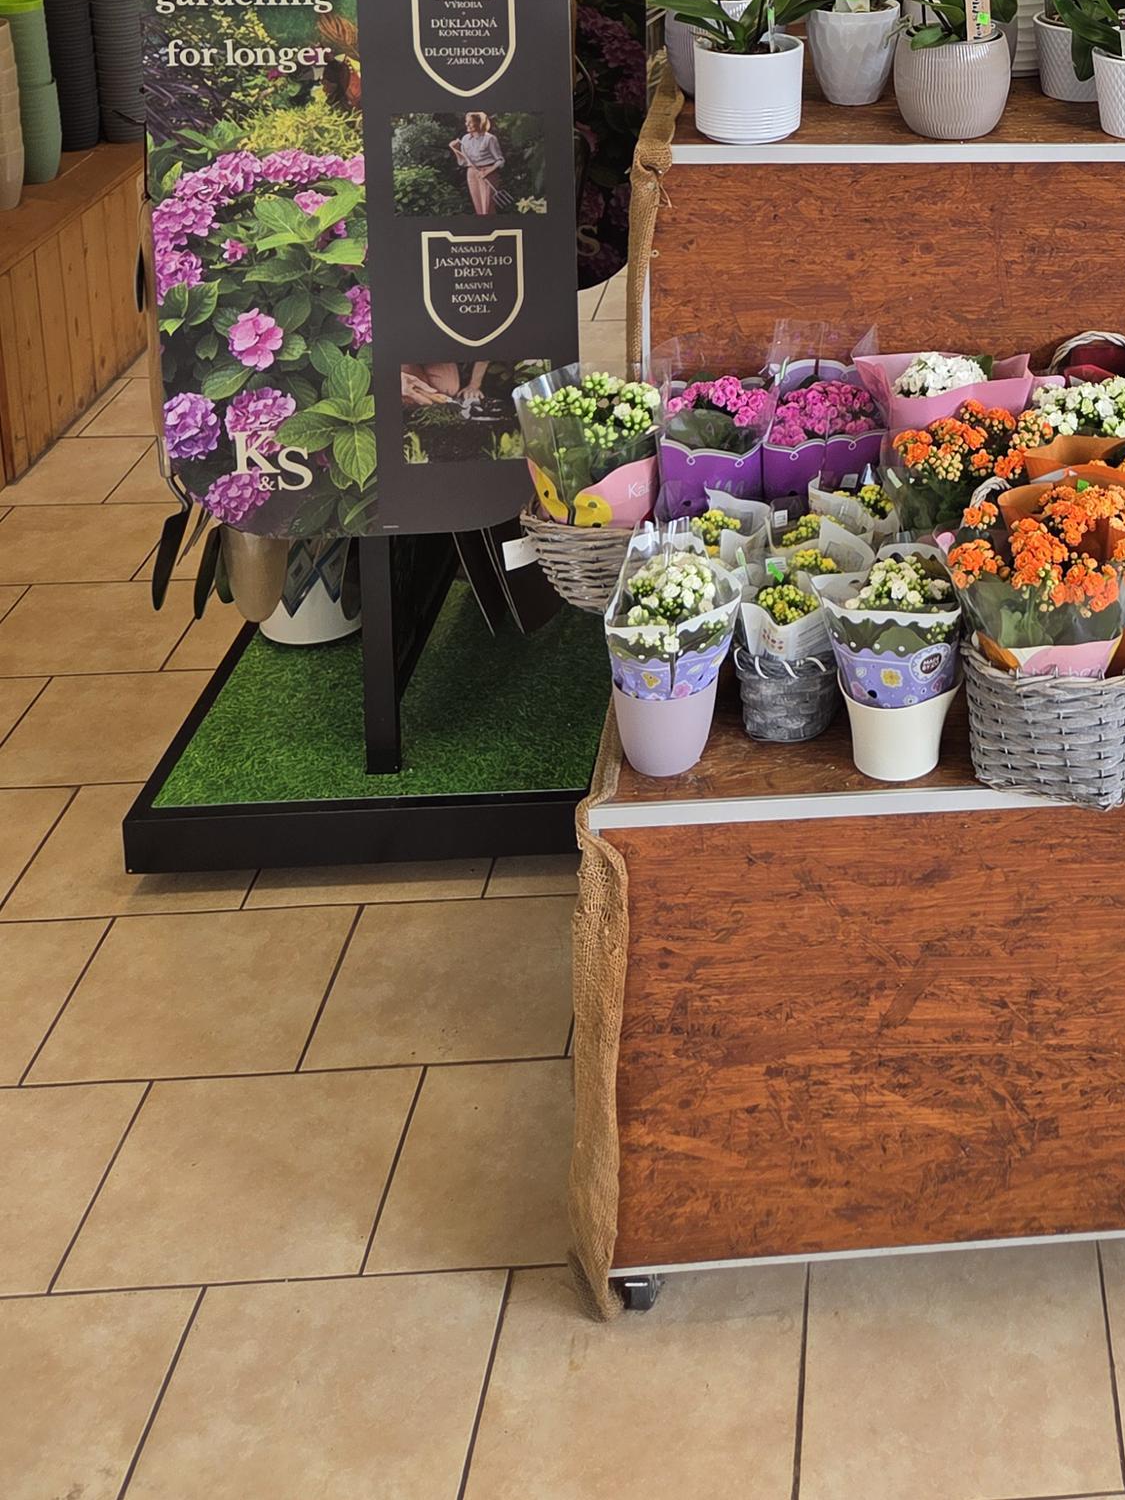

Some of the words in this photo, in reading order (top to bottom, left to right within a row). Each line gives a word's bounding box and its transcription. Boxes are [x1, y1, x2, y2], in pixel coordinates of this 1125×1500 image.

[444, 0, 483, 8] VÝROBA
[431, 16, 498, 28] DŮKLADNÁ
[438, 29, 490, 37] KONTROLA
[166, 39, 217, 67] for
[224, 38, 331, 73] longer
[424, 45, 506, 57] DLOUHODOBÁ
[434, 256, 513, 269] JASANOVÉHO
[454, 267, 493, 277] DŘEVA
[451, 292, 498, 303] KOVANÁ
[459, 304, 490, 314] OCEL
